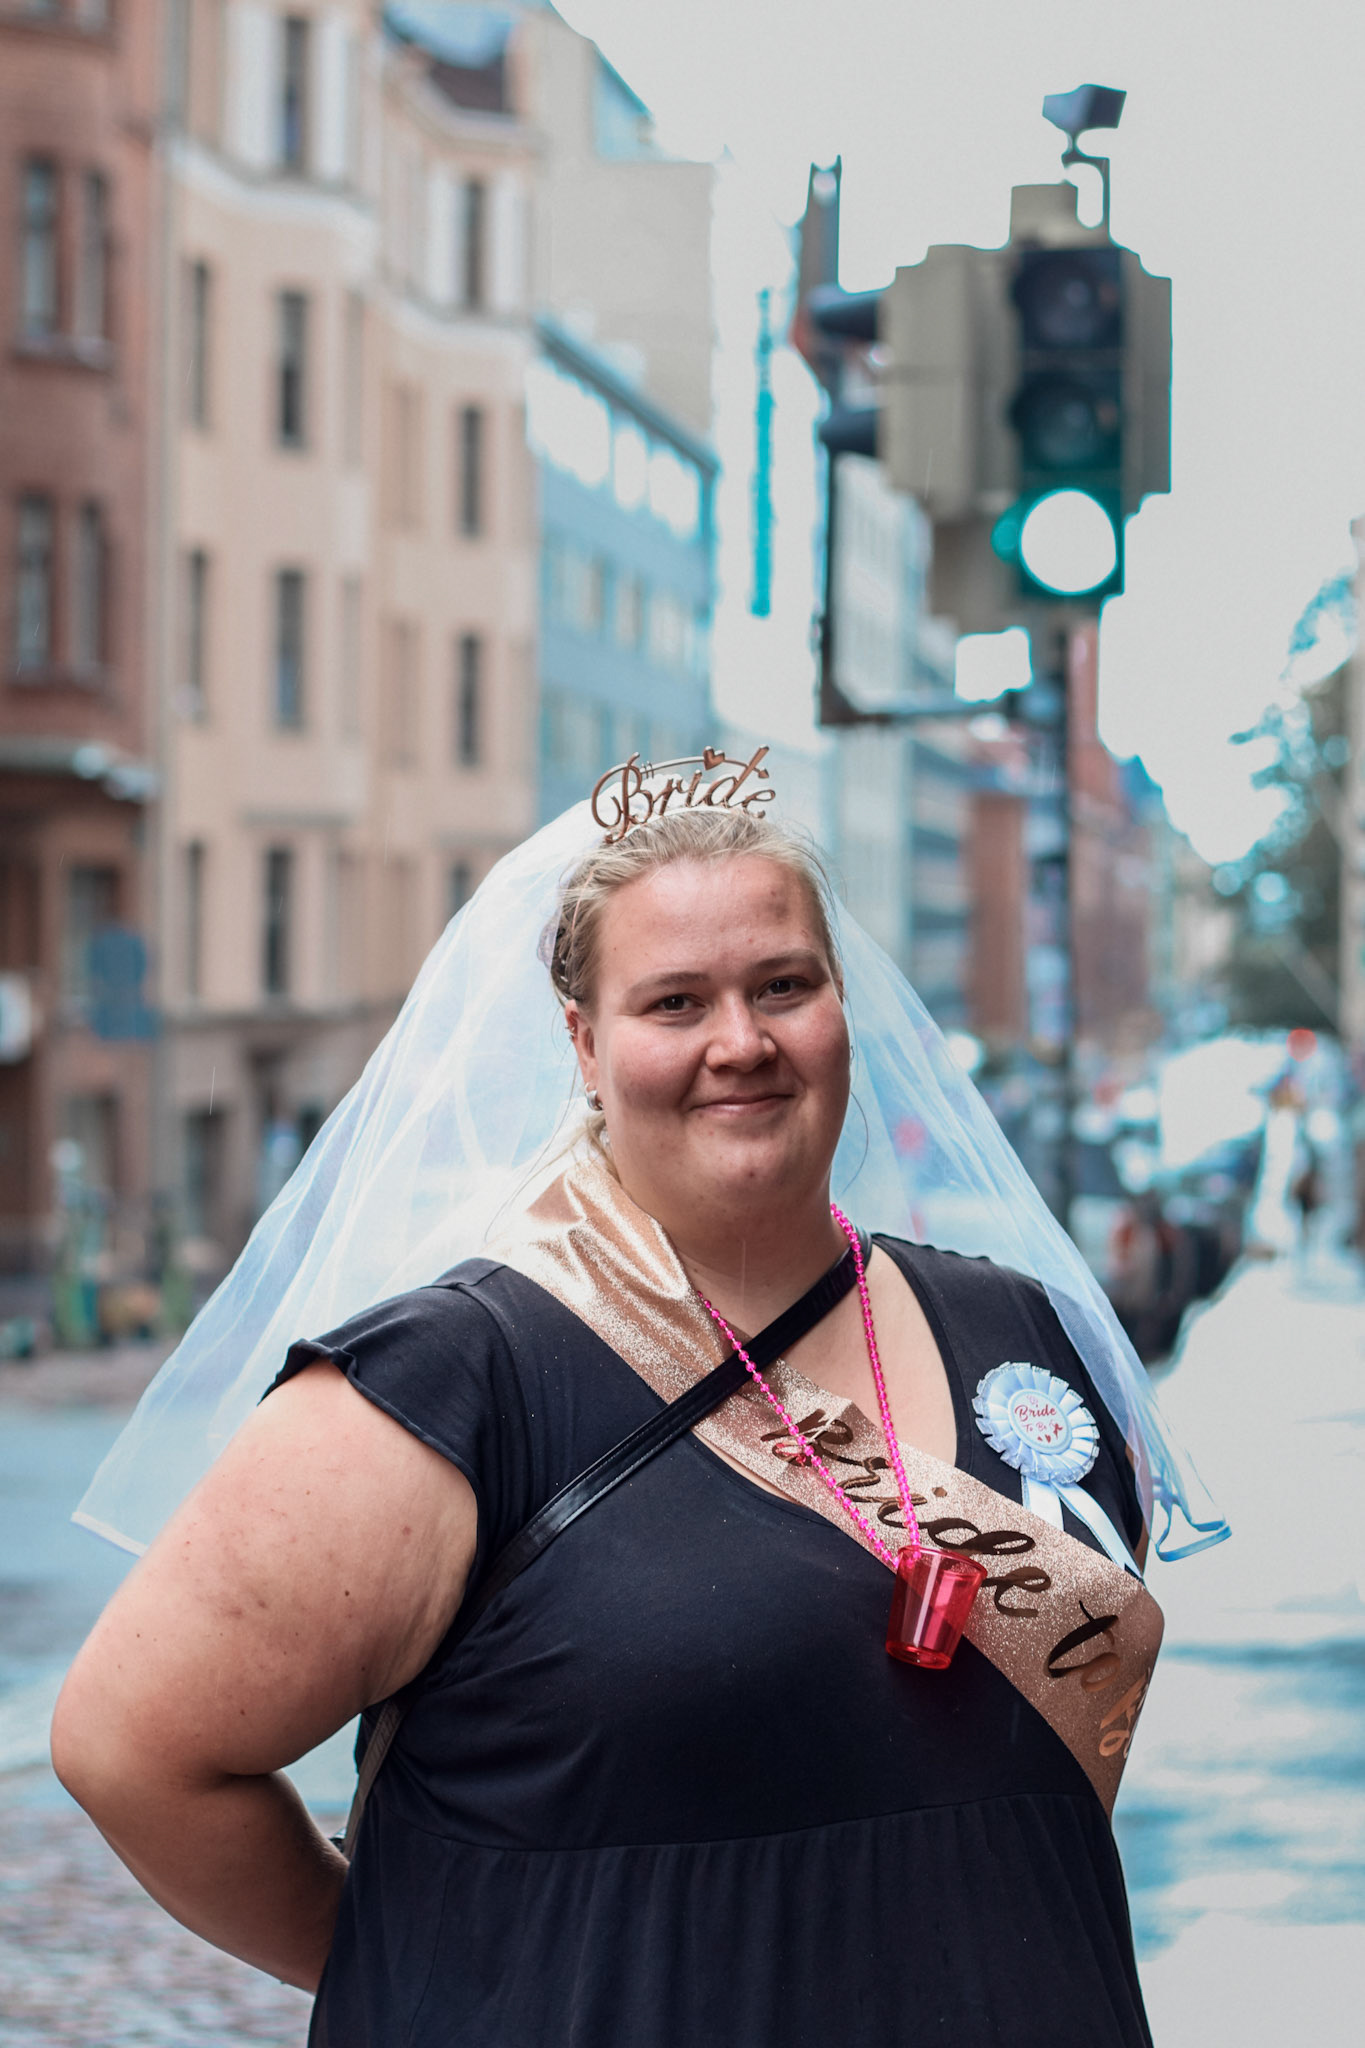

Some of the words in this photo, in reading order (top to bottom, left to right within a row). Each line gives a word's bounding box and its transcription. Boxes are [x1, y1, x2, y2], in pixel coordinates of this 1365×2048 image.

[591, 744, 776, 844] Bride
[1014, 1404, 1057, 1422] Bride
[1021, 1423, 1034, 1433] To
[760, 1408, 1051, 1618] Bride
